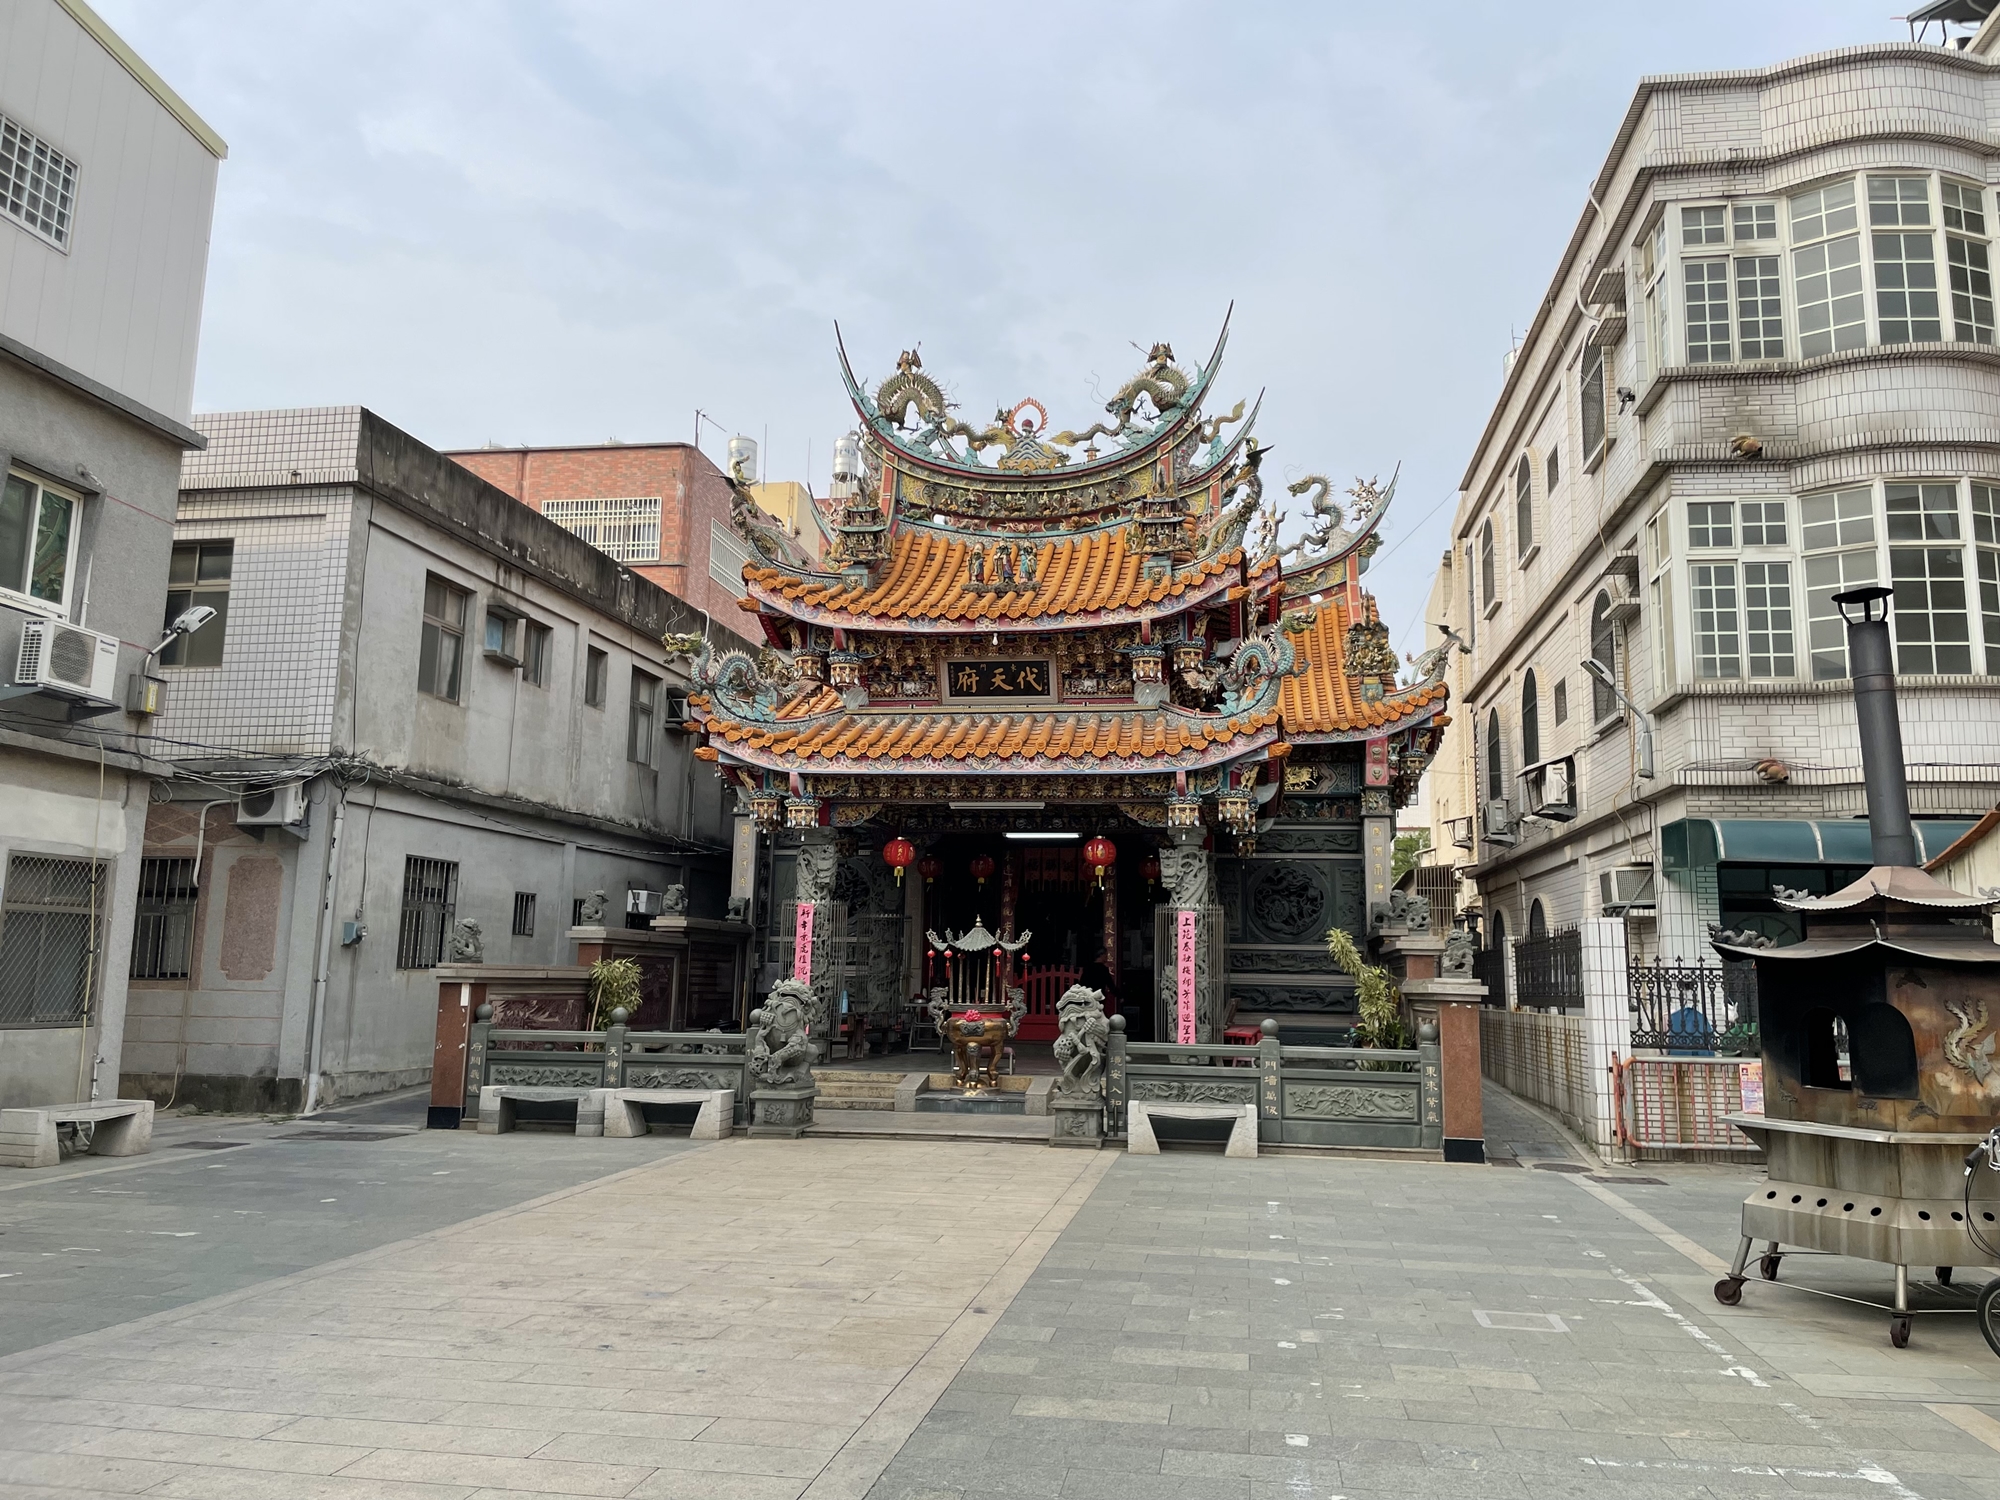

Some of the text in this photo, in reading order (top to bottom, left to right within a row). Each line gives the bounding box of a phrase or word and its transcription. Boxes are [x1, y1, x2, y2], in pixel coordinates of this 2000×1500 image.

[956, 665, 1042, 693] 代天府
[1425, 1066, 1439, 1123] 東來紫氣
